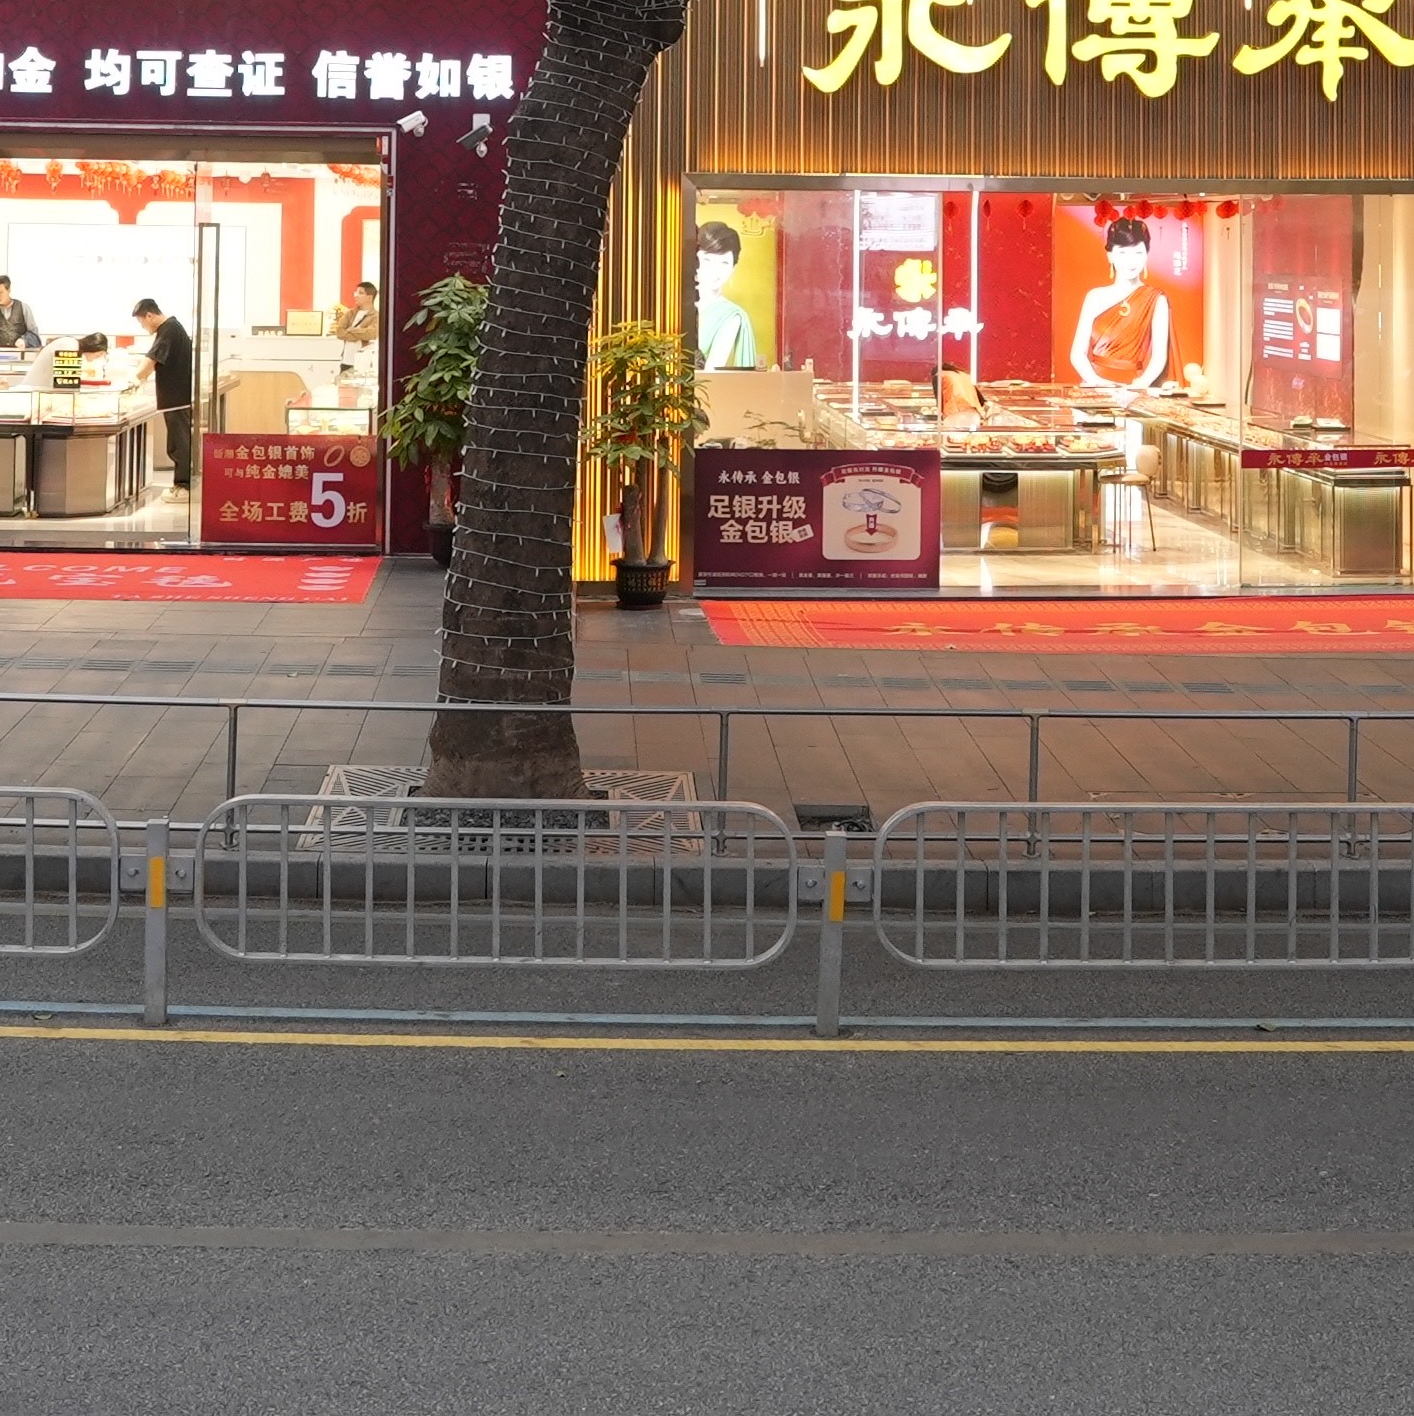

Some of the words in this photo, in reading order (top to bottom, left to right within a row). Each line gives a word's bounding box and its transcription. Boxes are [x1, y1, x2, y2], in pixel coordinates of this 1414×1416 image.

[85, 49, 286, 98] 均可查证
[311, 50, 515, 101] 信誉如银
[718, 470, 758, 484] 永传承
[762, 471, 800, 484] 金包银
[708, 495, 806, 519] 足银升级
[720, 519, 794, 544] 金包银
